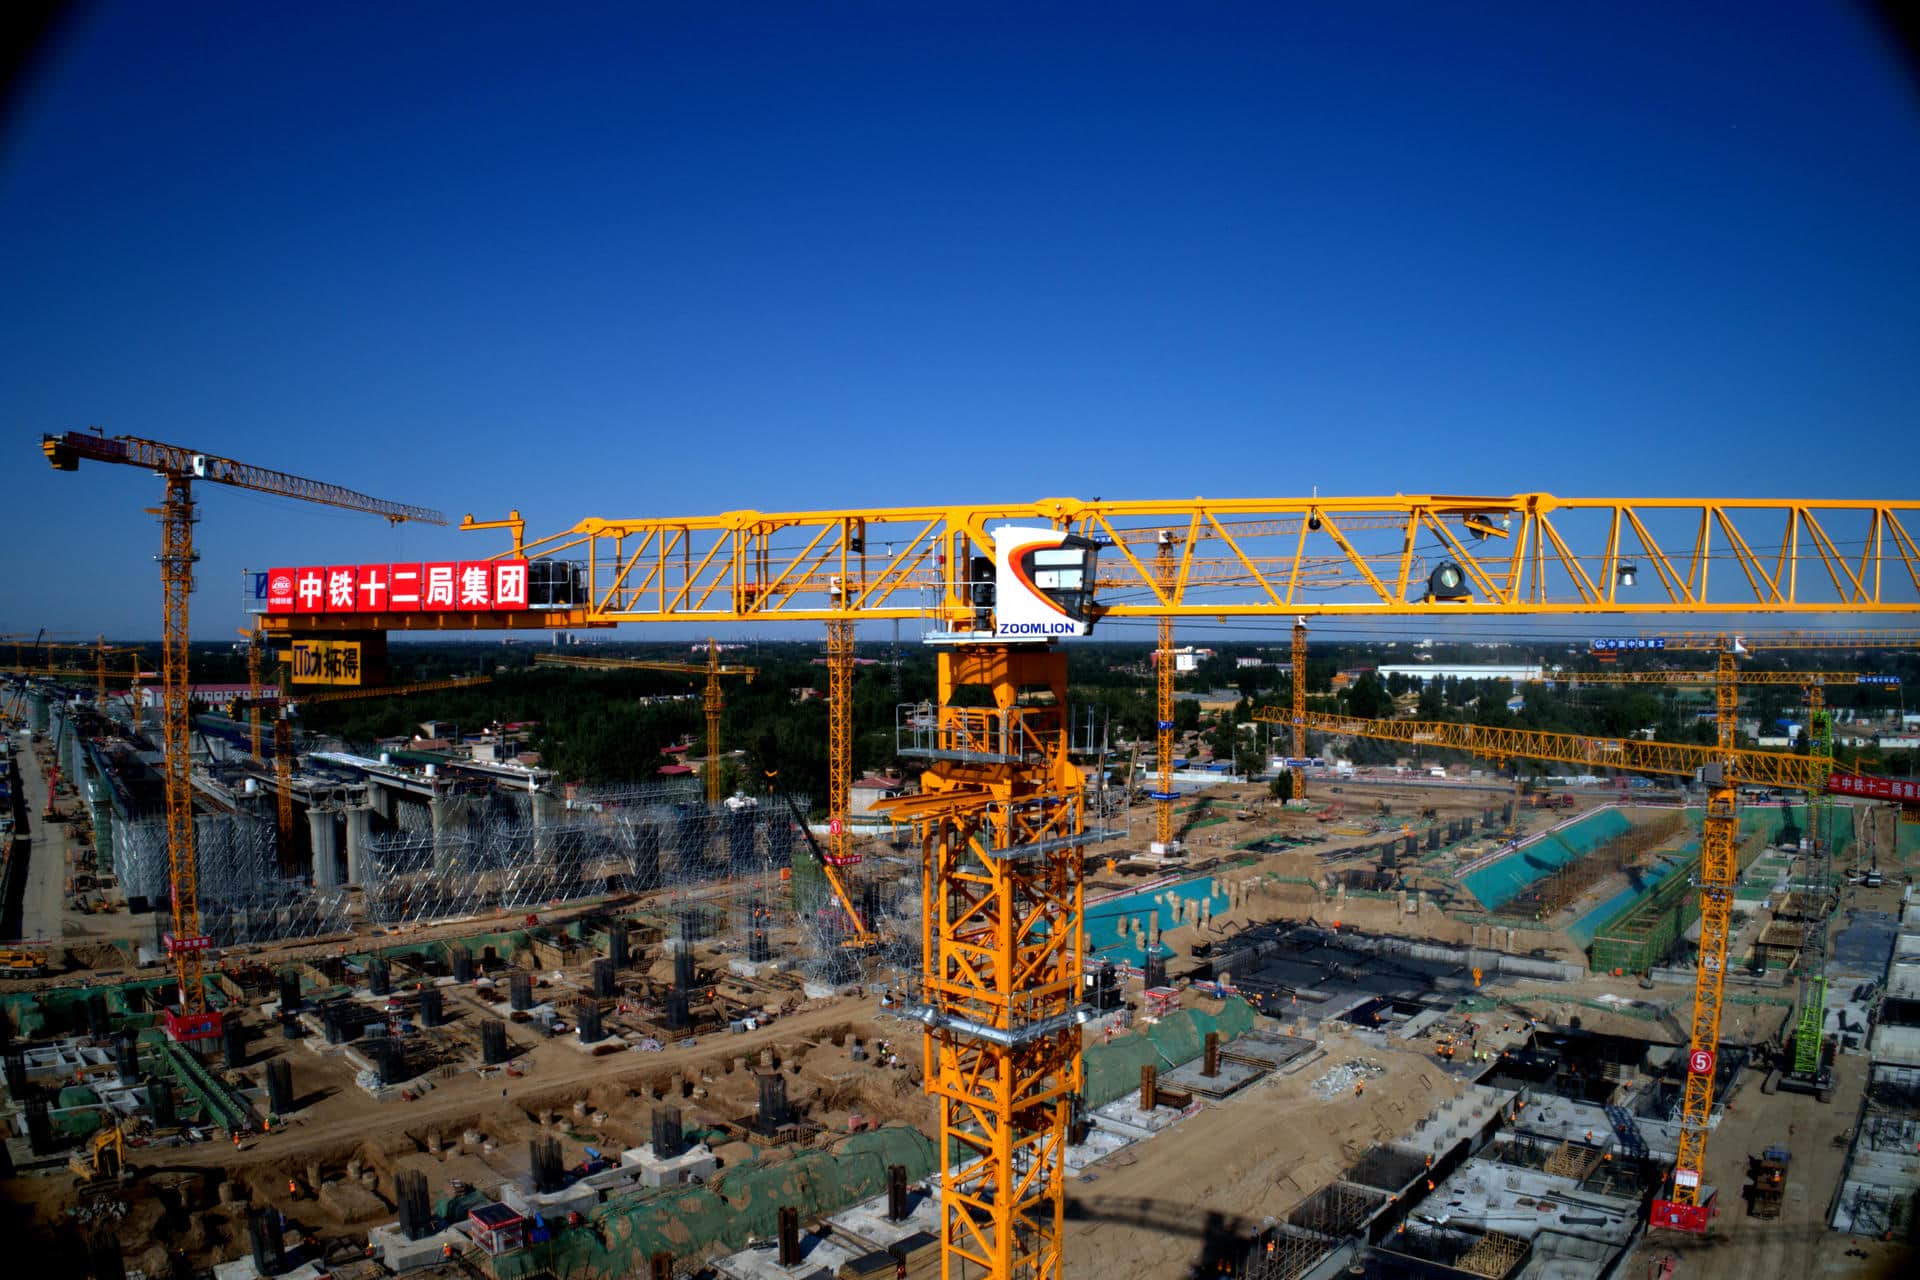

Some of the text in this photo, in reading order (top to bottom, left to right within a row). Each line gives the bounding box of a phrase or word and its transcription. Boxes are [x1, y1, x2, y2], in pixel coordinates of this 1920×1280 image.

[299, 565, 525, 608] 中铁十二局集团
[1000, 623, 1074, 634] ZOOMLION
